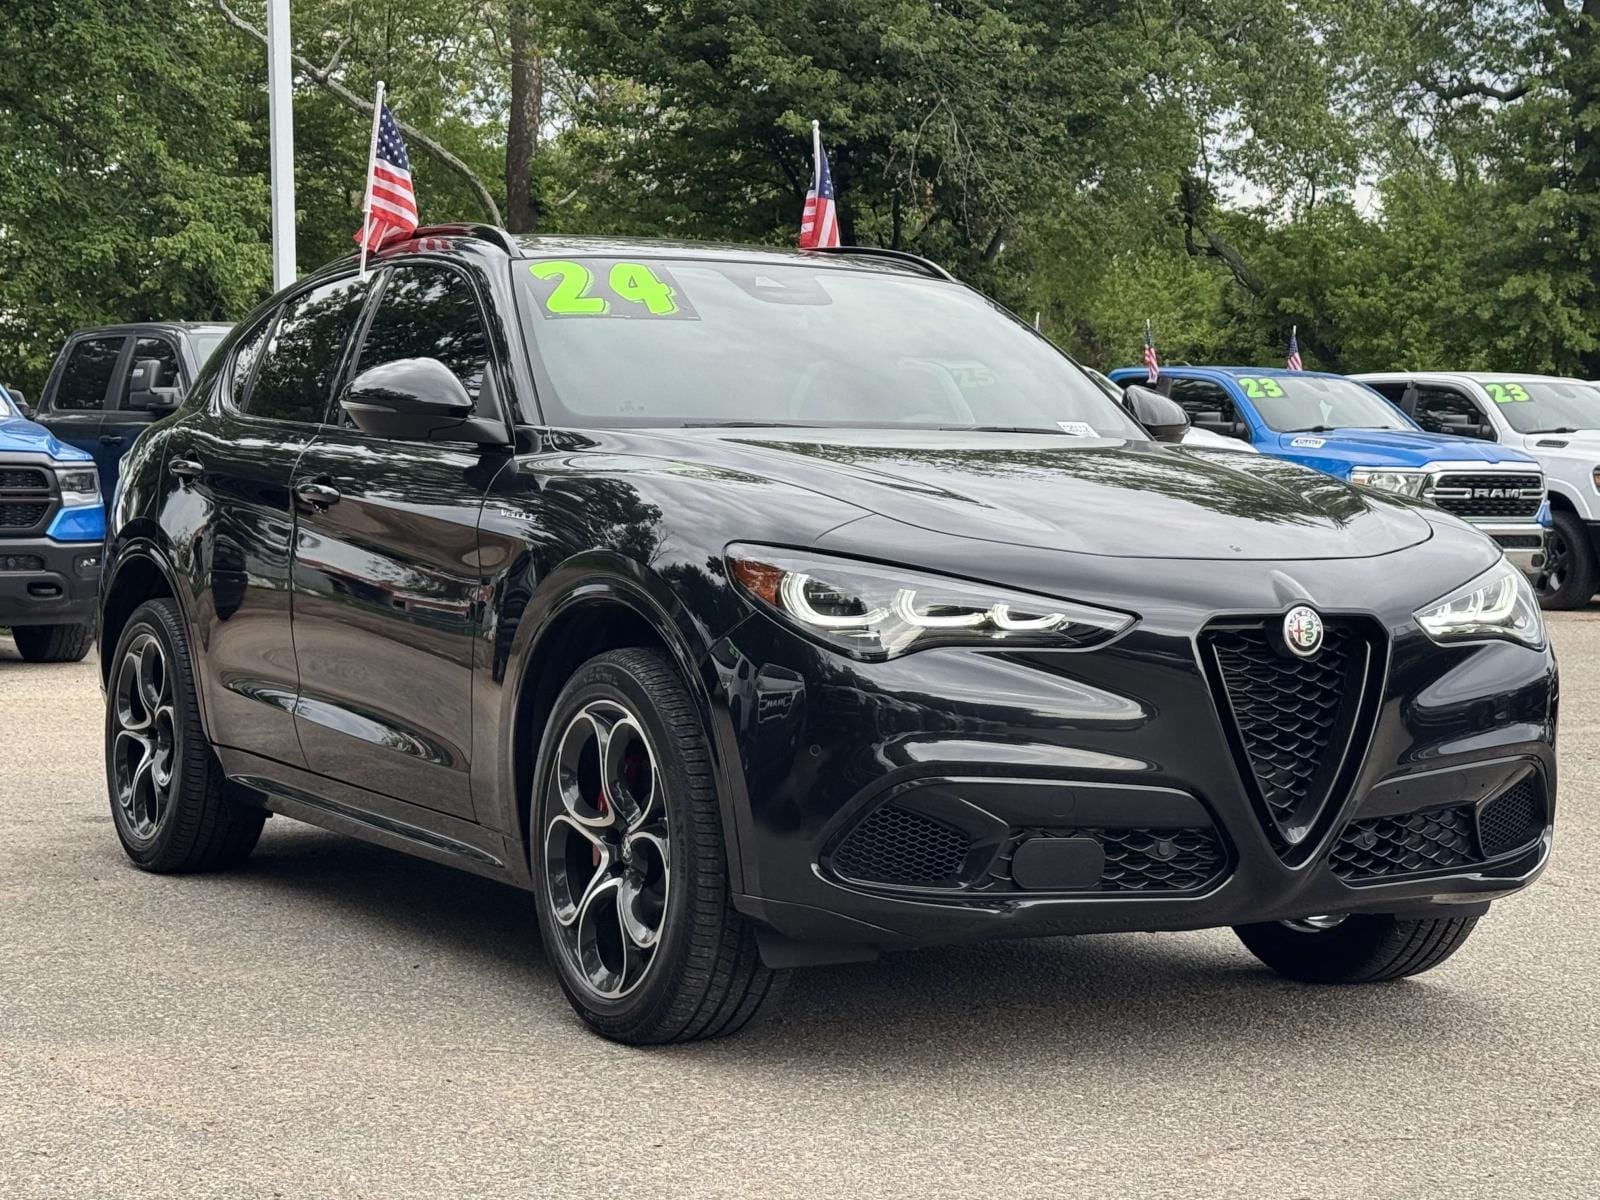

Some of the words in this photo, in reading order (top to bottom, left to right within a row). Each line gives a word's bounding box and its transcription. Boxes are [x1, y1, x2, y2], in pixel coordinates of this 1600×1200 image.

[529, 260, 678, 316] 24
[1238, 378, 1283, 398] 23
[1484, 383, 1530, 403] 23
[1473, 488, 1520, 498] RAM
